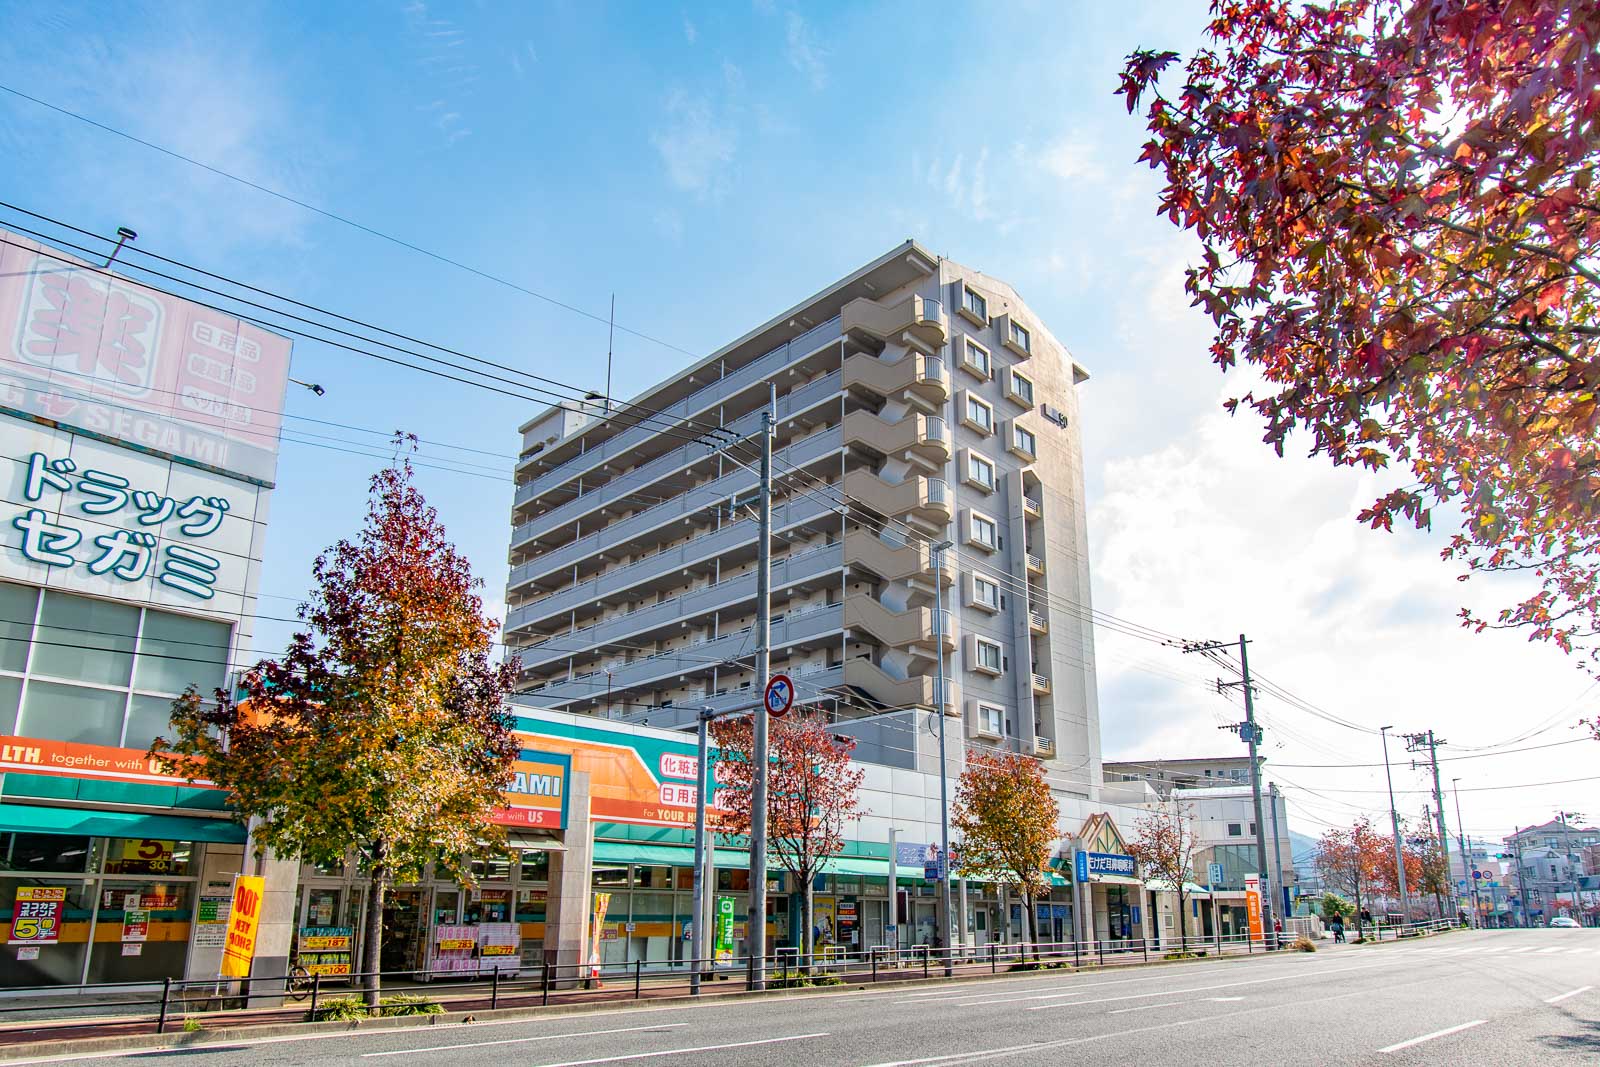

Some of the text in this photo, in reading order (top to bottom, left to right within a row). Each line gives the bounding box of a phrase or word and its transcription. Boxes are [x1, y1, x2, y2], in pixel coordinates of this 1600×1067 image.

[85, 404, 229, 465] SEGAMI
[24, 452, 230, 537] ドラッグ
[13, 509, 220, 600] セガミ
[51, 752, 110, 767] together
[115, 759, 142, 771] with
[507, 811, 525, 821] with
[527, 811, 544, 824] US
[643, 809, 654, 817] For
[657, 809, 685, 821] YOUR
[21, 902, 57, 910] ココカラ
[20, 909, 56, 917] ポイント
[724, 918, 732, 944] LINE
[327, 939, 345, 947] 187
[329, 966, 347, 974] 100
